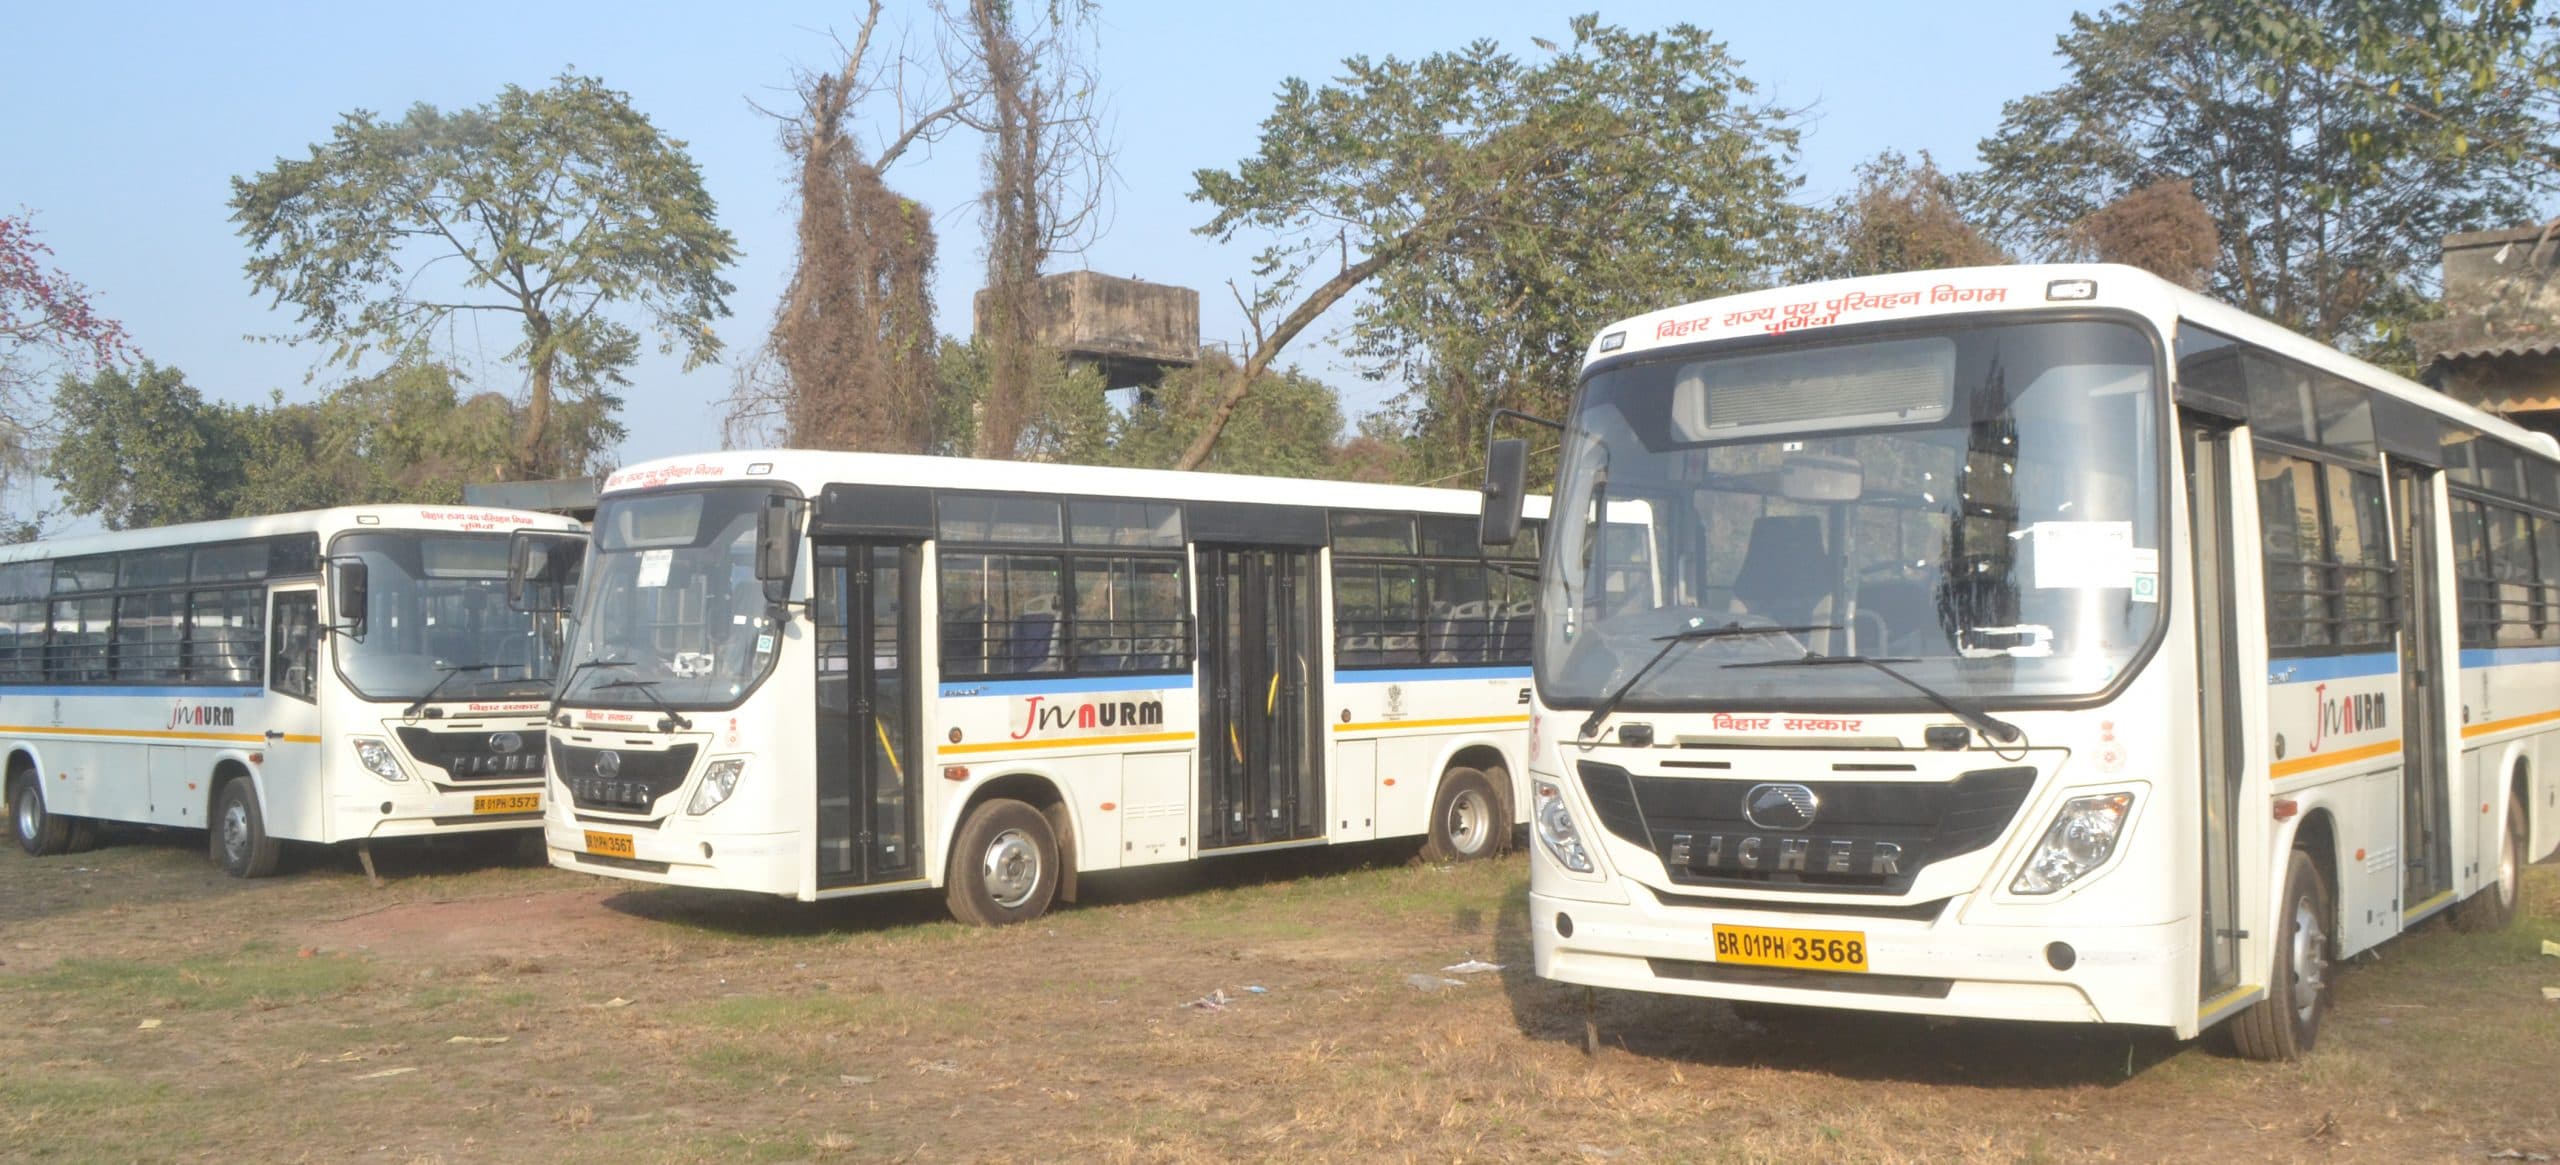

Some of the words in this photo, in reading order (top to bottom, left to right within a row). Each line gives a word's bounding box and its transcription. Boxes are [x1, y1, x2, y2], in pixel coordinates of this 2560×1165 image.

[1655, 317, 1712, 340] बिहार
[1723, 306, 1775, 327] राज्य
[1826, 290, 1921, 315] परिवहन
[1930, 284, 2008, 305] निगम
[1712, 712, 1772, 731] बिहार
[1783, 718, 1863, 732] सरकार
[509, 796, 539, 809] 3573
[608, 836, 633, 853] 3567
[1670, 834, 1901, 874] EICHER
[1717, 931, 1739, 955] BR
[1743, 933, 1785, 959] 01PH
[1792, 937, 1864, 965] 3568
